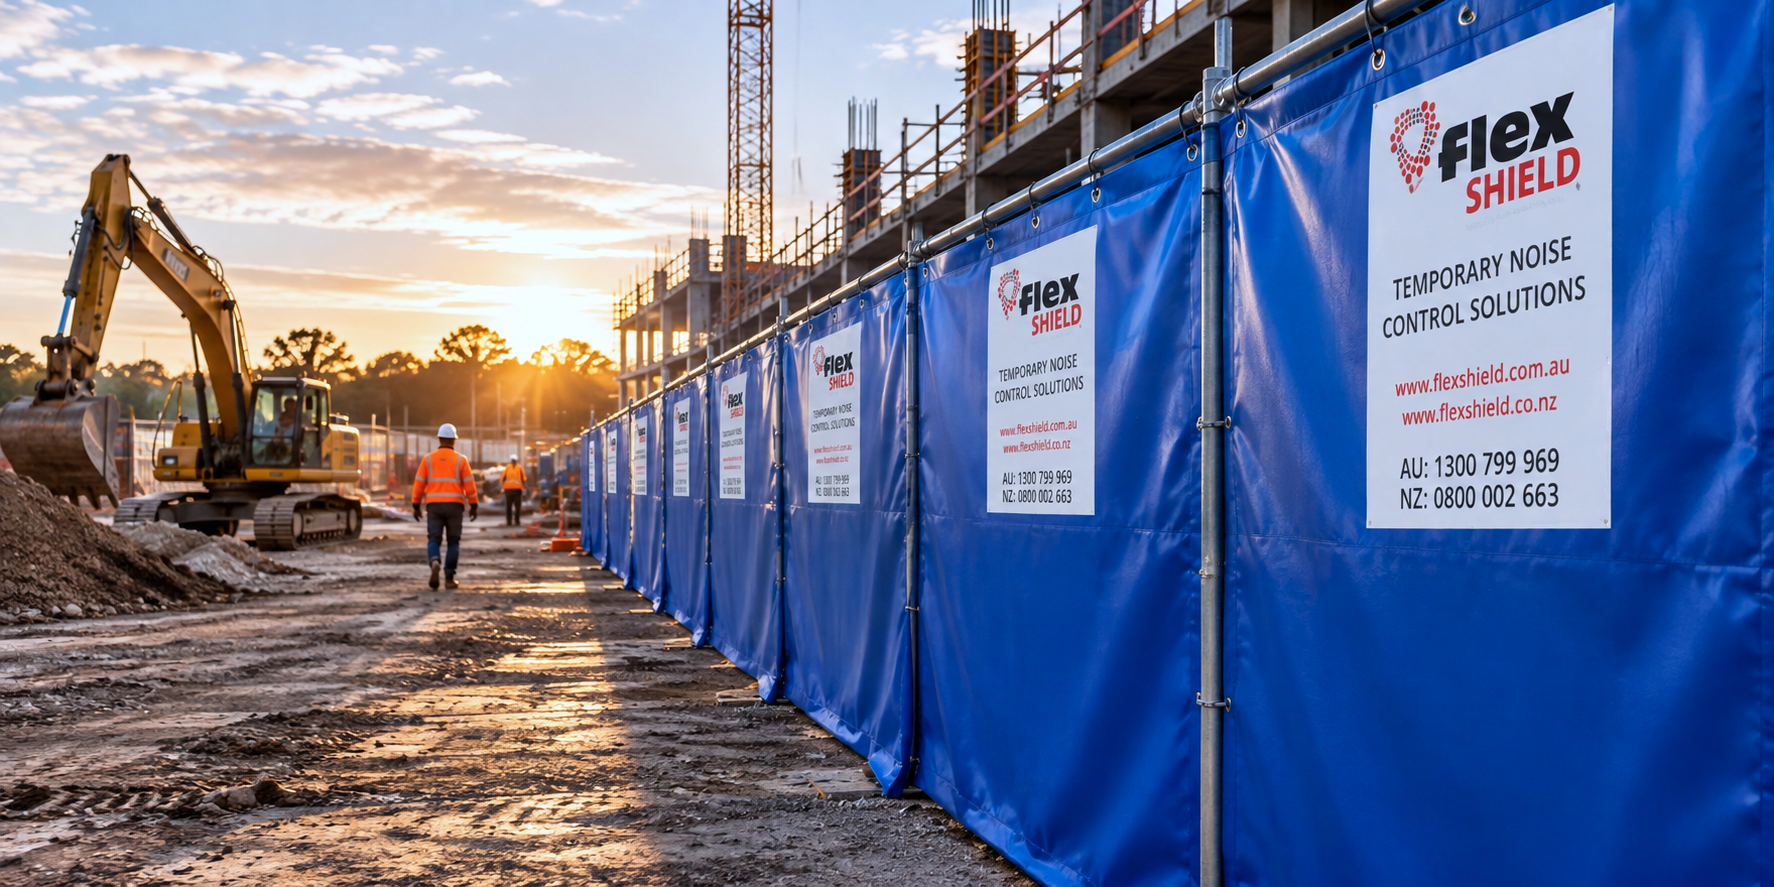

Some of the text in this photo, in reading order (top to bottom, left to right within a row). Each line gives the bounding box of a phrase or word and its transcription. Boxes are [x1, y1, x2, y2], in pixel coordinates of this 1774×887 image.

[1438, 91, 1574, 183] flex
[1466, 147, 1581, 214] SHIELD
[1393, 236, 1572, 300] TEMPORARY NOISE
[1019, 273, 1080, 316] flex
[1383, 275, 1586, 338] CONTROL SOLUTIONS
[1031, 303, 1082, 336] SHIELD
[823, 351, 853, 377] flex
[999, 353, 1078, 382] TEMPORARY NOISE
[1395, 358, 1570, 397] www.flexshield.com.au
[829, 371, 855, 391] SHIELD
[994, 375, 1084, 404] CONTROL SOLUTIONS
[1402, 395, 1557, 426] www.flexshield.co.nz
[999, 419, 1078, 437] www.flexshield.com.au
[1002, 439, 1071, 454] www.flexshield.co.nz
[1002, 469, 1072, 485] AU: 1300 799 969
[1400, 447, 1559, 479] AU: 1300 799 969
[1002, 489, 1072, 504] NZ: 0800 002 663
[1400, 482, 1559, 509] NZ: 0800 002 663
